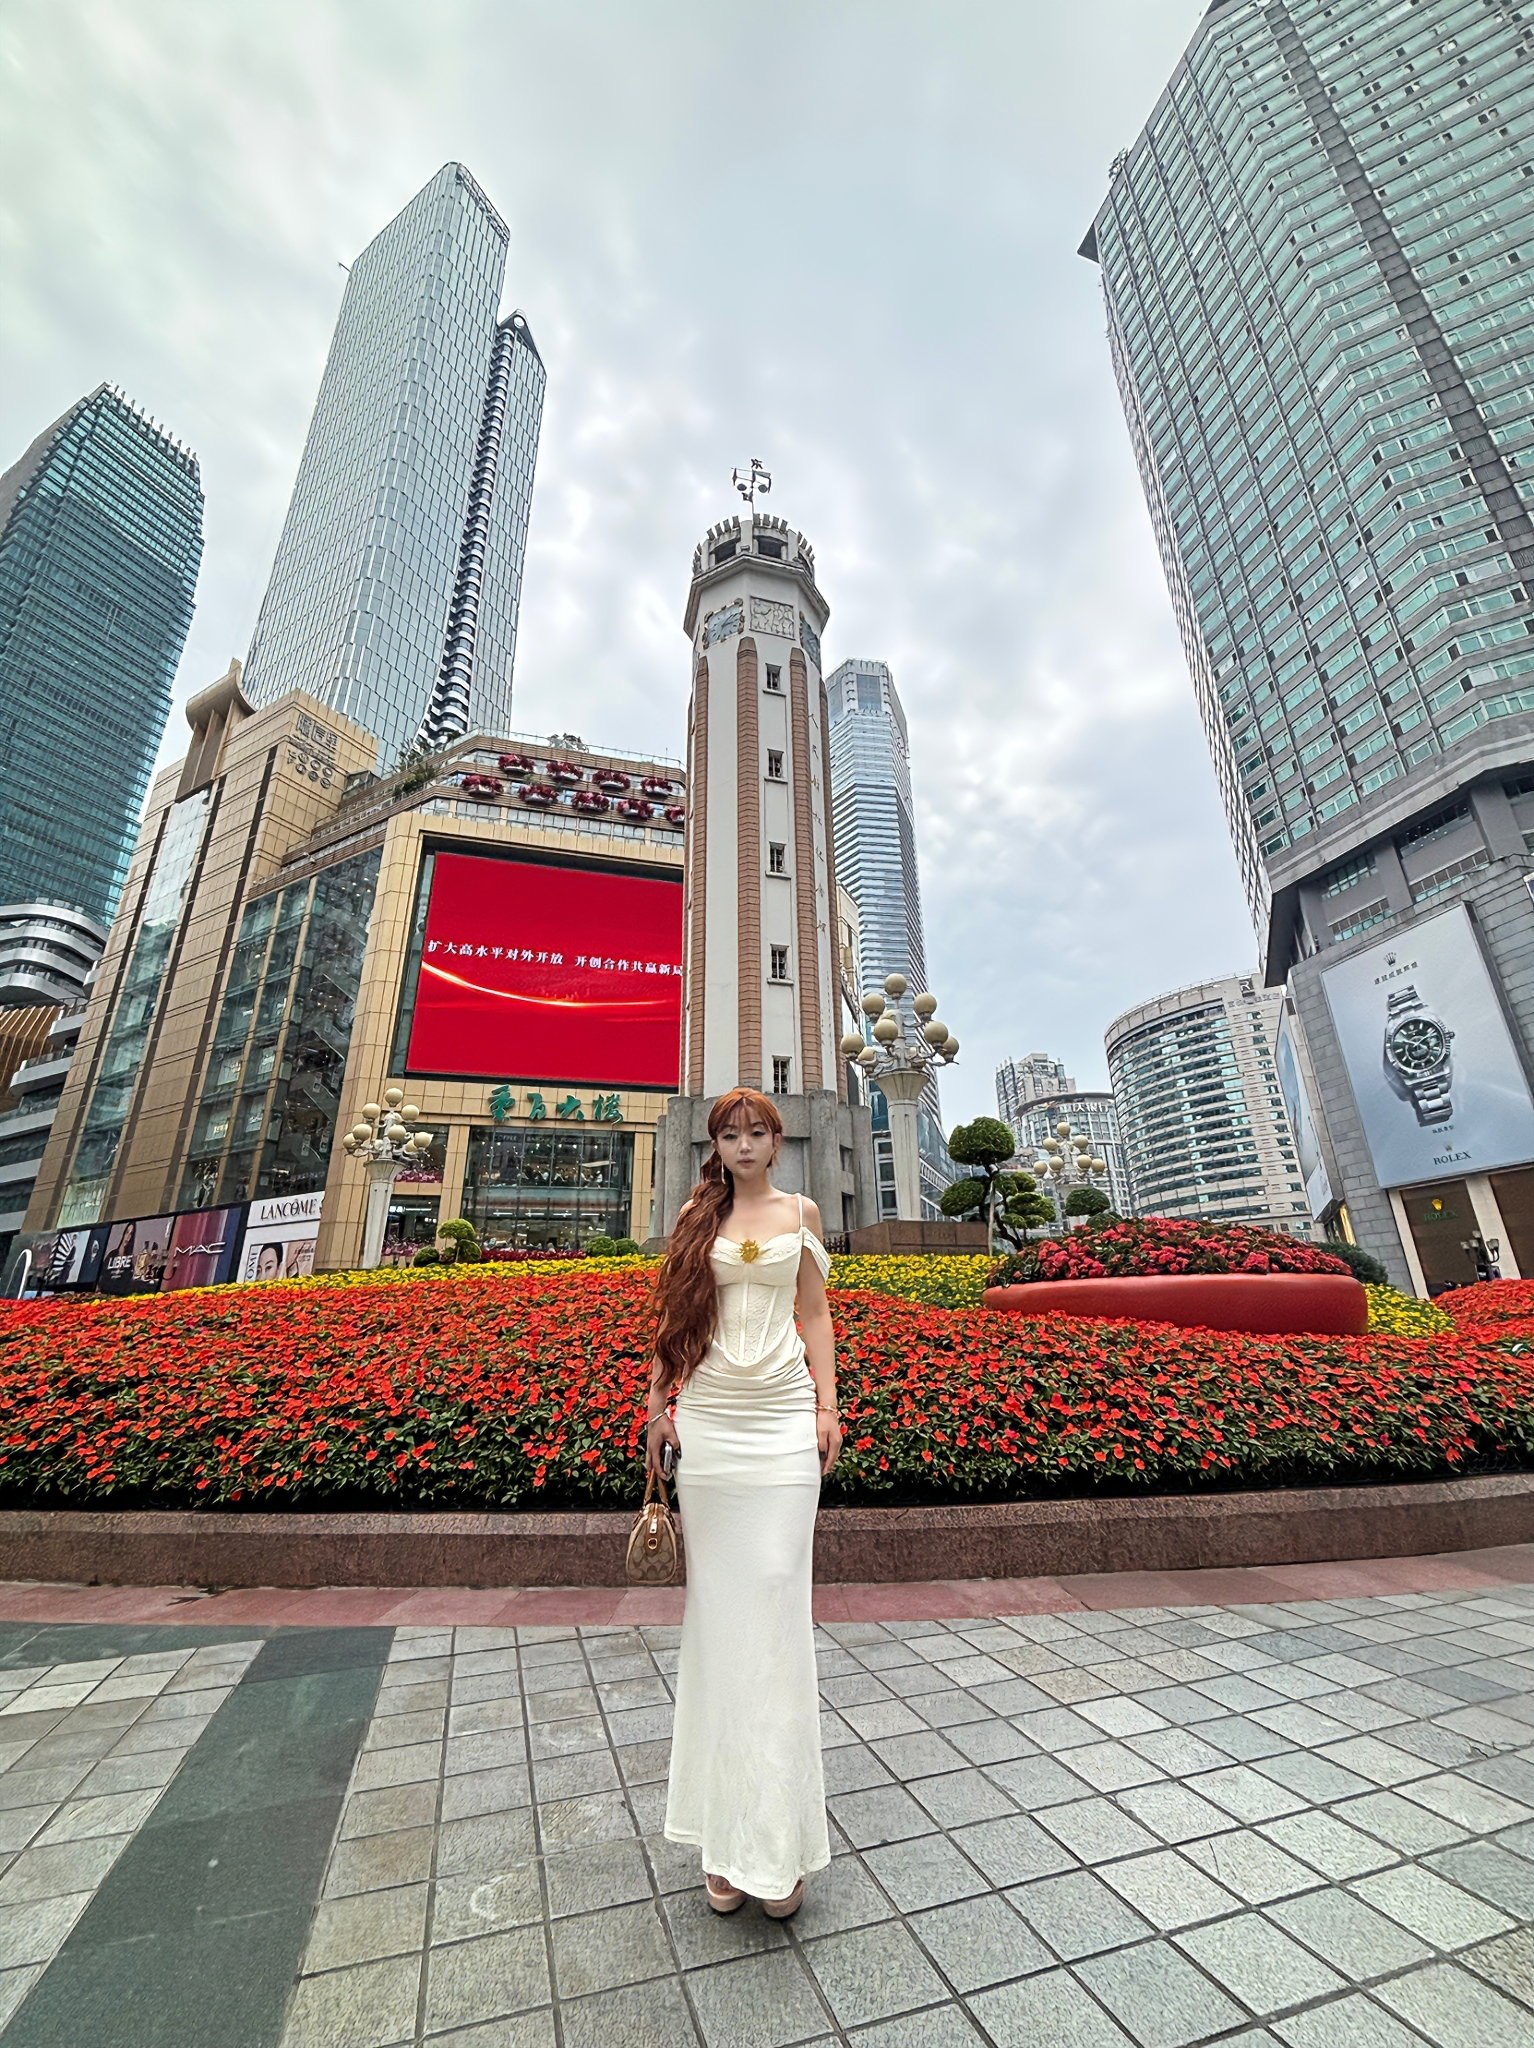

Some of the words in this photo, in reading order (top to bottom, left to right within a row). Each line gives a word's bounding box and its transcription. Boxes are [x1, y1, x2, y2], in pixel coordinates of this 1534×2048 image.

[427, 939, 563, 965] 扩大高水平对外开放
[1433, 1151, 1472, 1165] ROLEX
[261, 1199, 318, 1220] LANCÔME
[107, 1255, 133, 1269] LIBRE
